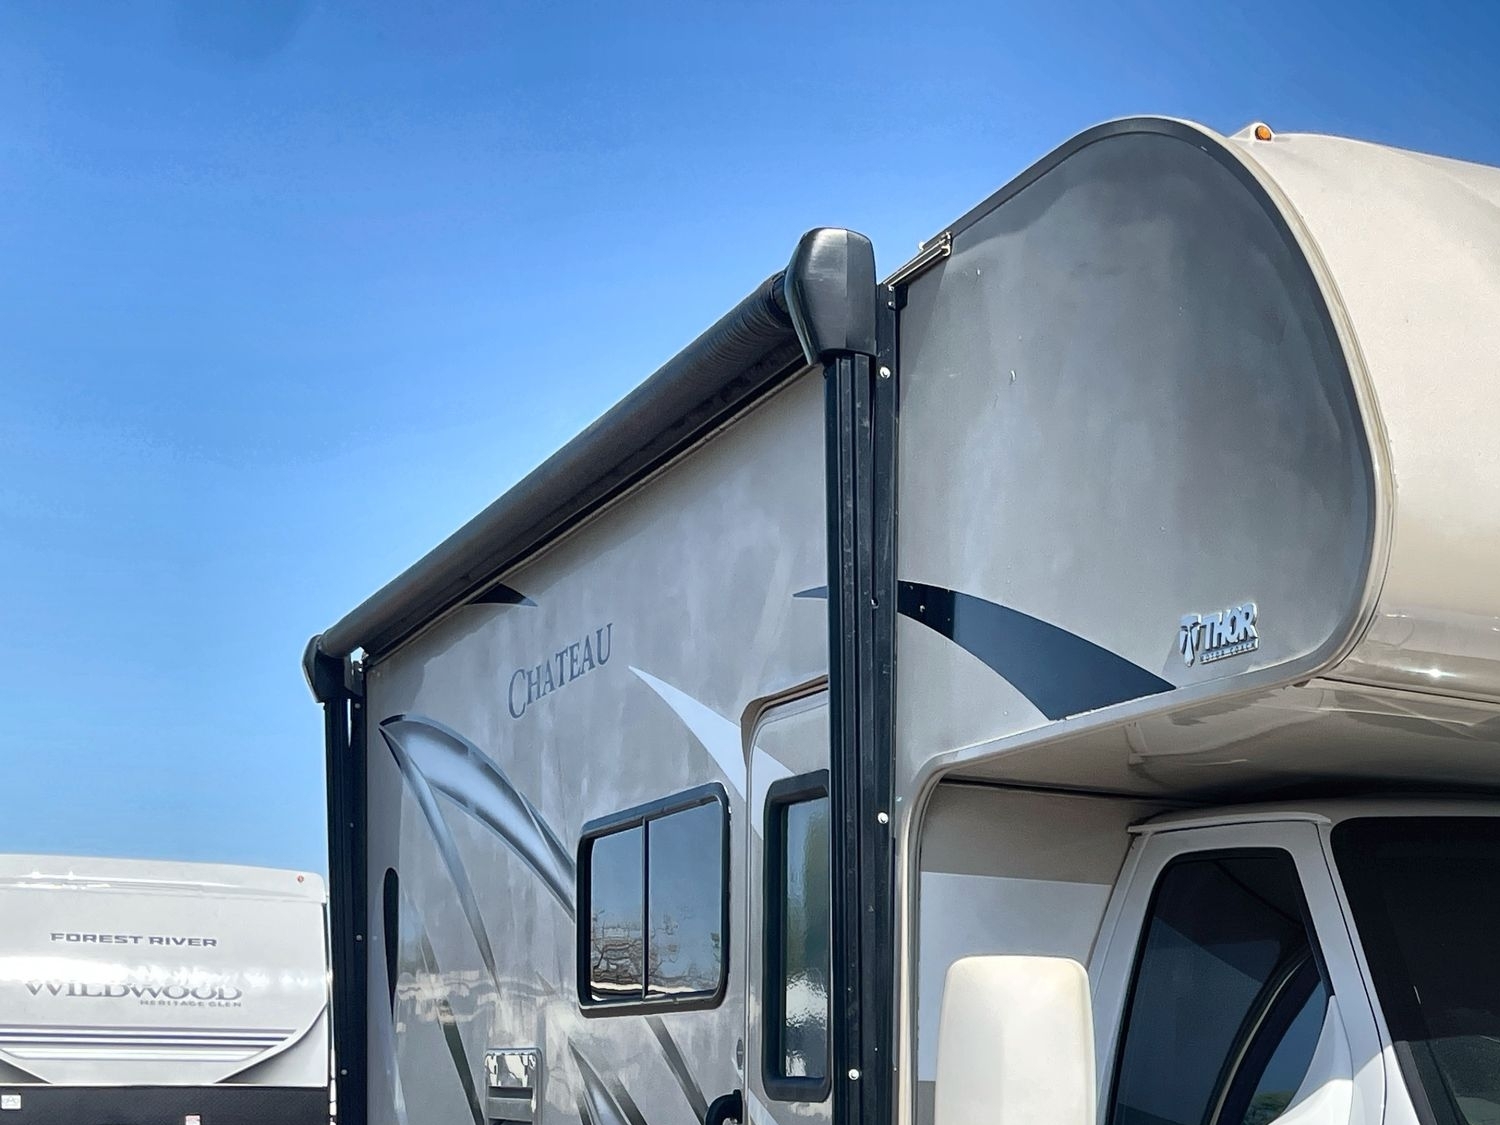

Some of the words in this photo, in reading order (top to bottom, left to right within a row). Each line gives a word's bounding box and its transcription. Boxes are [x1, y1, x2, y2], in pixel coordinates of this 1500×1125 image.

[1201, 602, 1258, 650] THOR
[508, 622, 613, 719] CHATEAU
[50, 932, 143, 945] FOREST
[148, 936, 217, 947] RIVER
